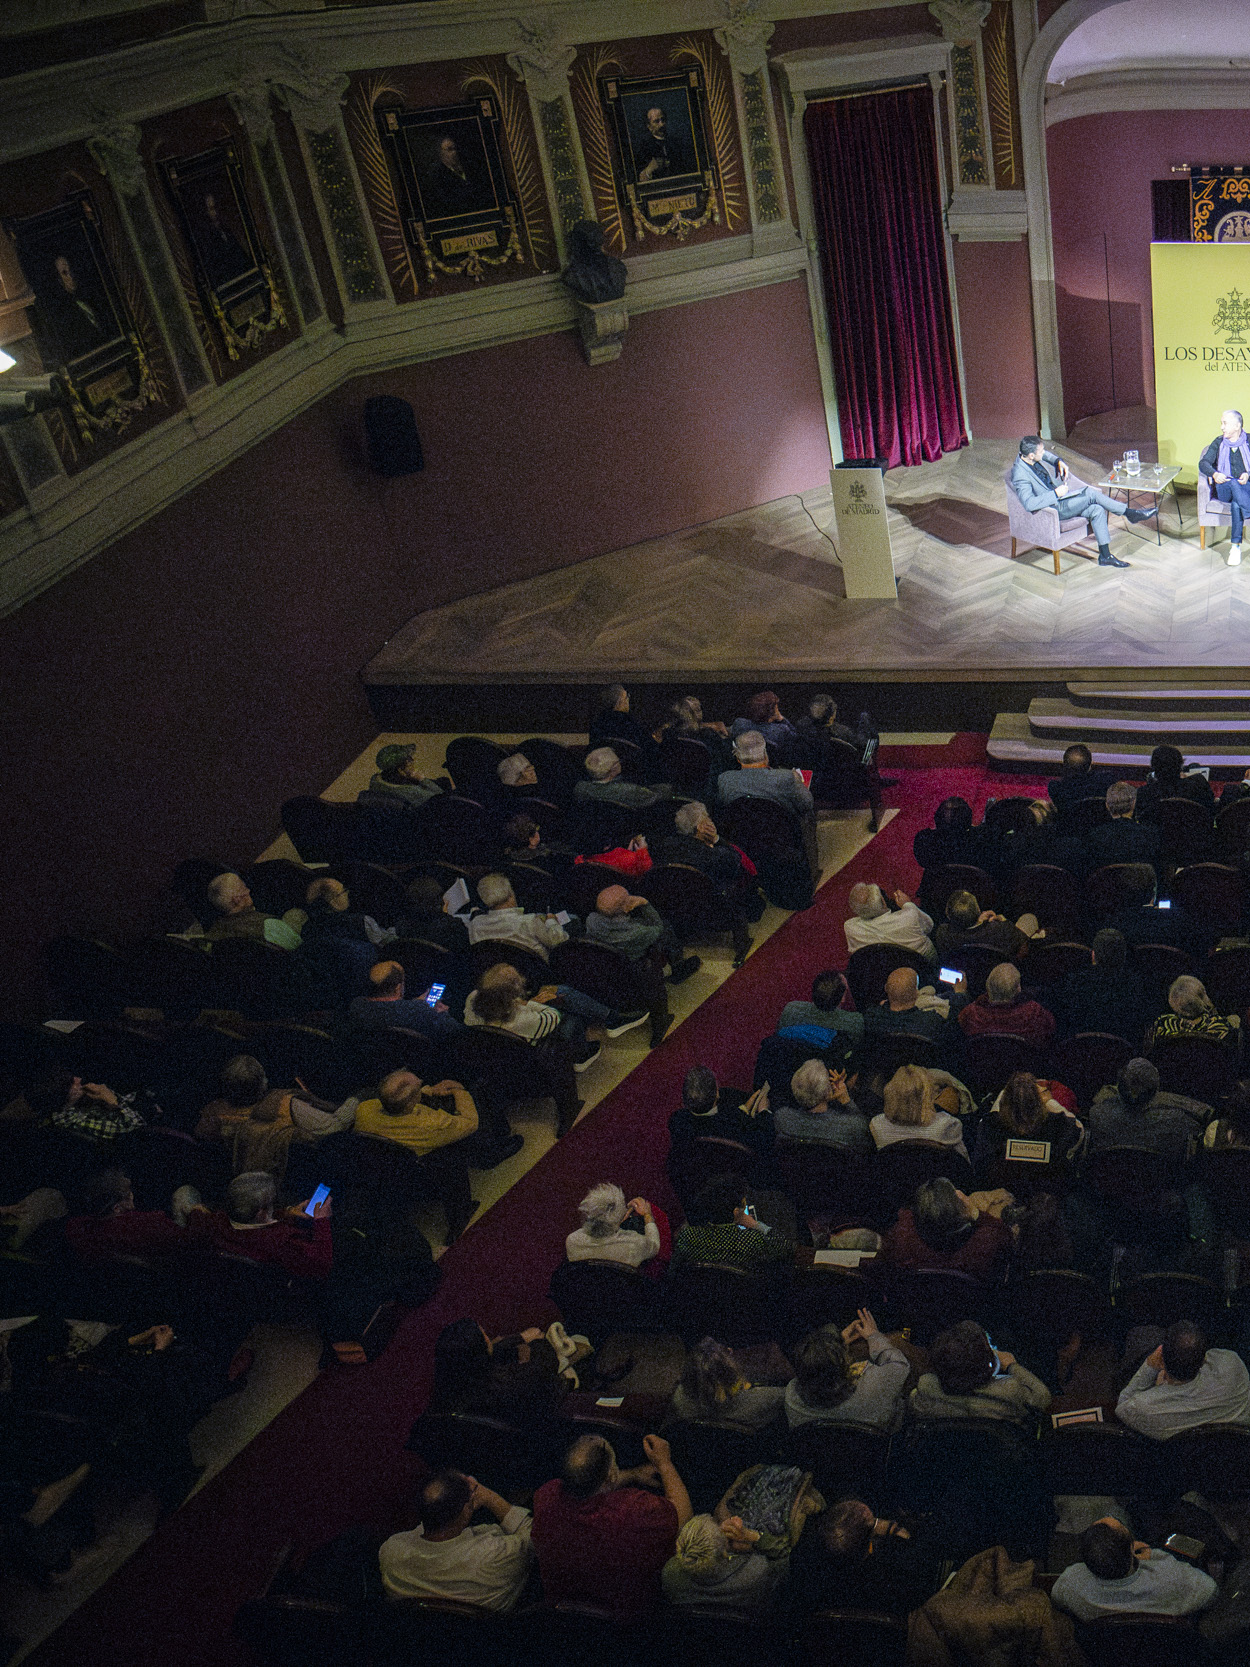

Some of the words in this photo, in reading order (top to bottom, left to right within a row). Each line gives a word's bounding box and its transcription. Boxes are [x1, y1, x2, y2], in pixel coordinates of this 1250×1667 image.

[466, 233, 496, 248] RIVAS
[1164, 347, 1198, 361] LOS
[1204, 361, 1219, 371] del
